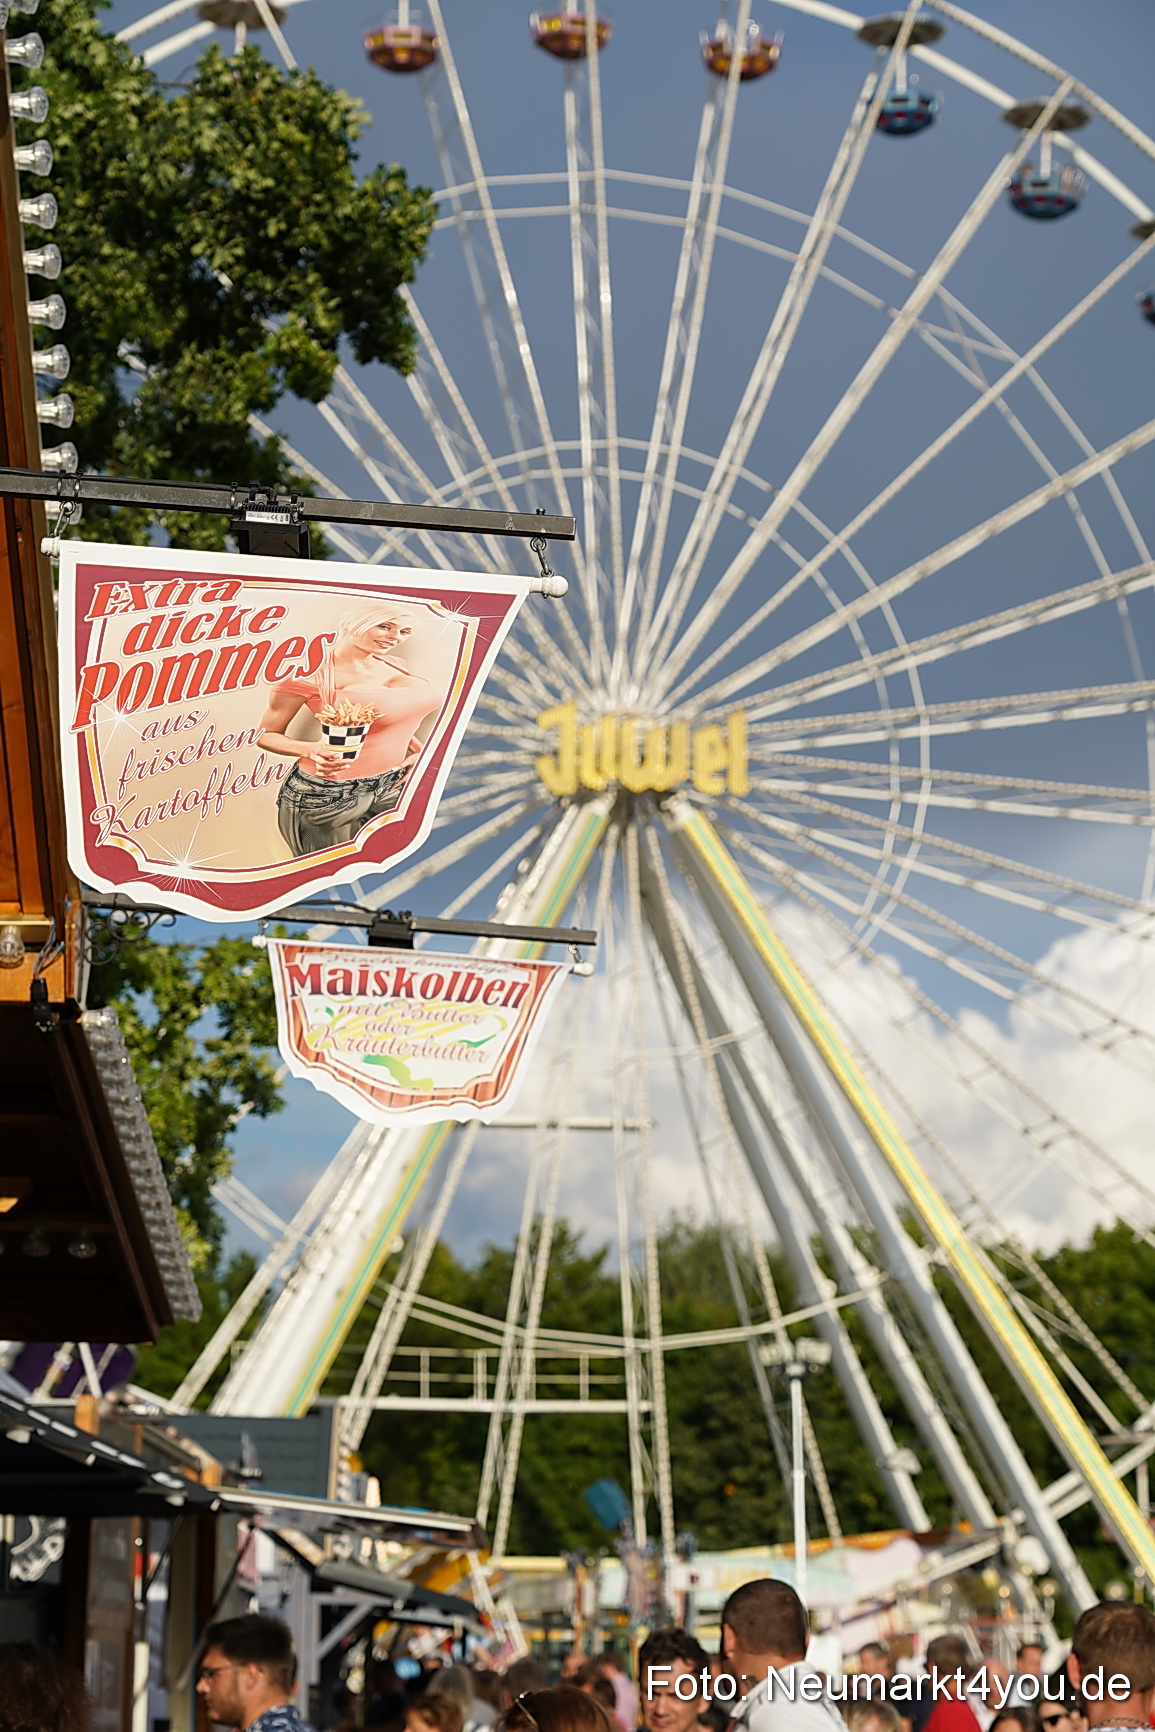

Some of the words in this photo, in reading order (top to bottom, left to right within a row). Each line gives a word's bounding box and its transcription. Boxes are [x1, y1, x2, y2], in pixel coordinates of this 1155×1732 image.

[85, 578, 245, 622] Extra
[121, 603, 287, 656] dicke
[69, 631, 337, 734] Pommes
[140, 708, 209, 742] aus
[117, 725, 264, 800] frischen
[535, 702, 751, 797] Juwel
[89, 752, 289, 846] Kartoffeln
[285, 963, 531, 1009] Maiskolben
[364, 1016, 416, 1036] oder
[391, 999, 485, 1026] Butter
[310, 1022, 491, 1064] Kräuterbutter
